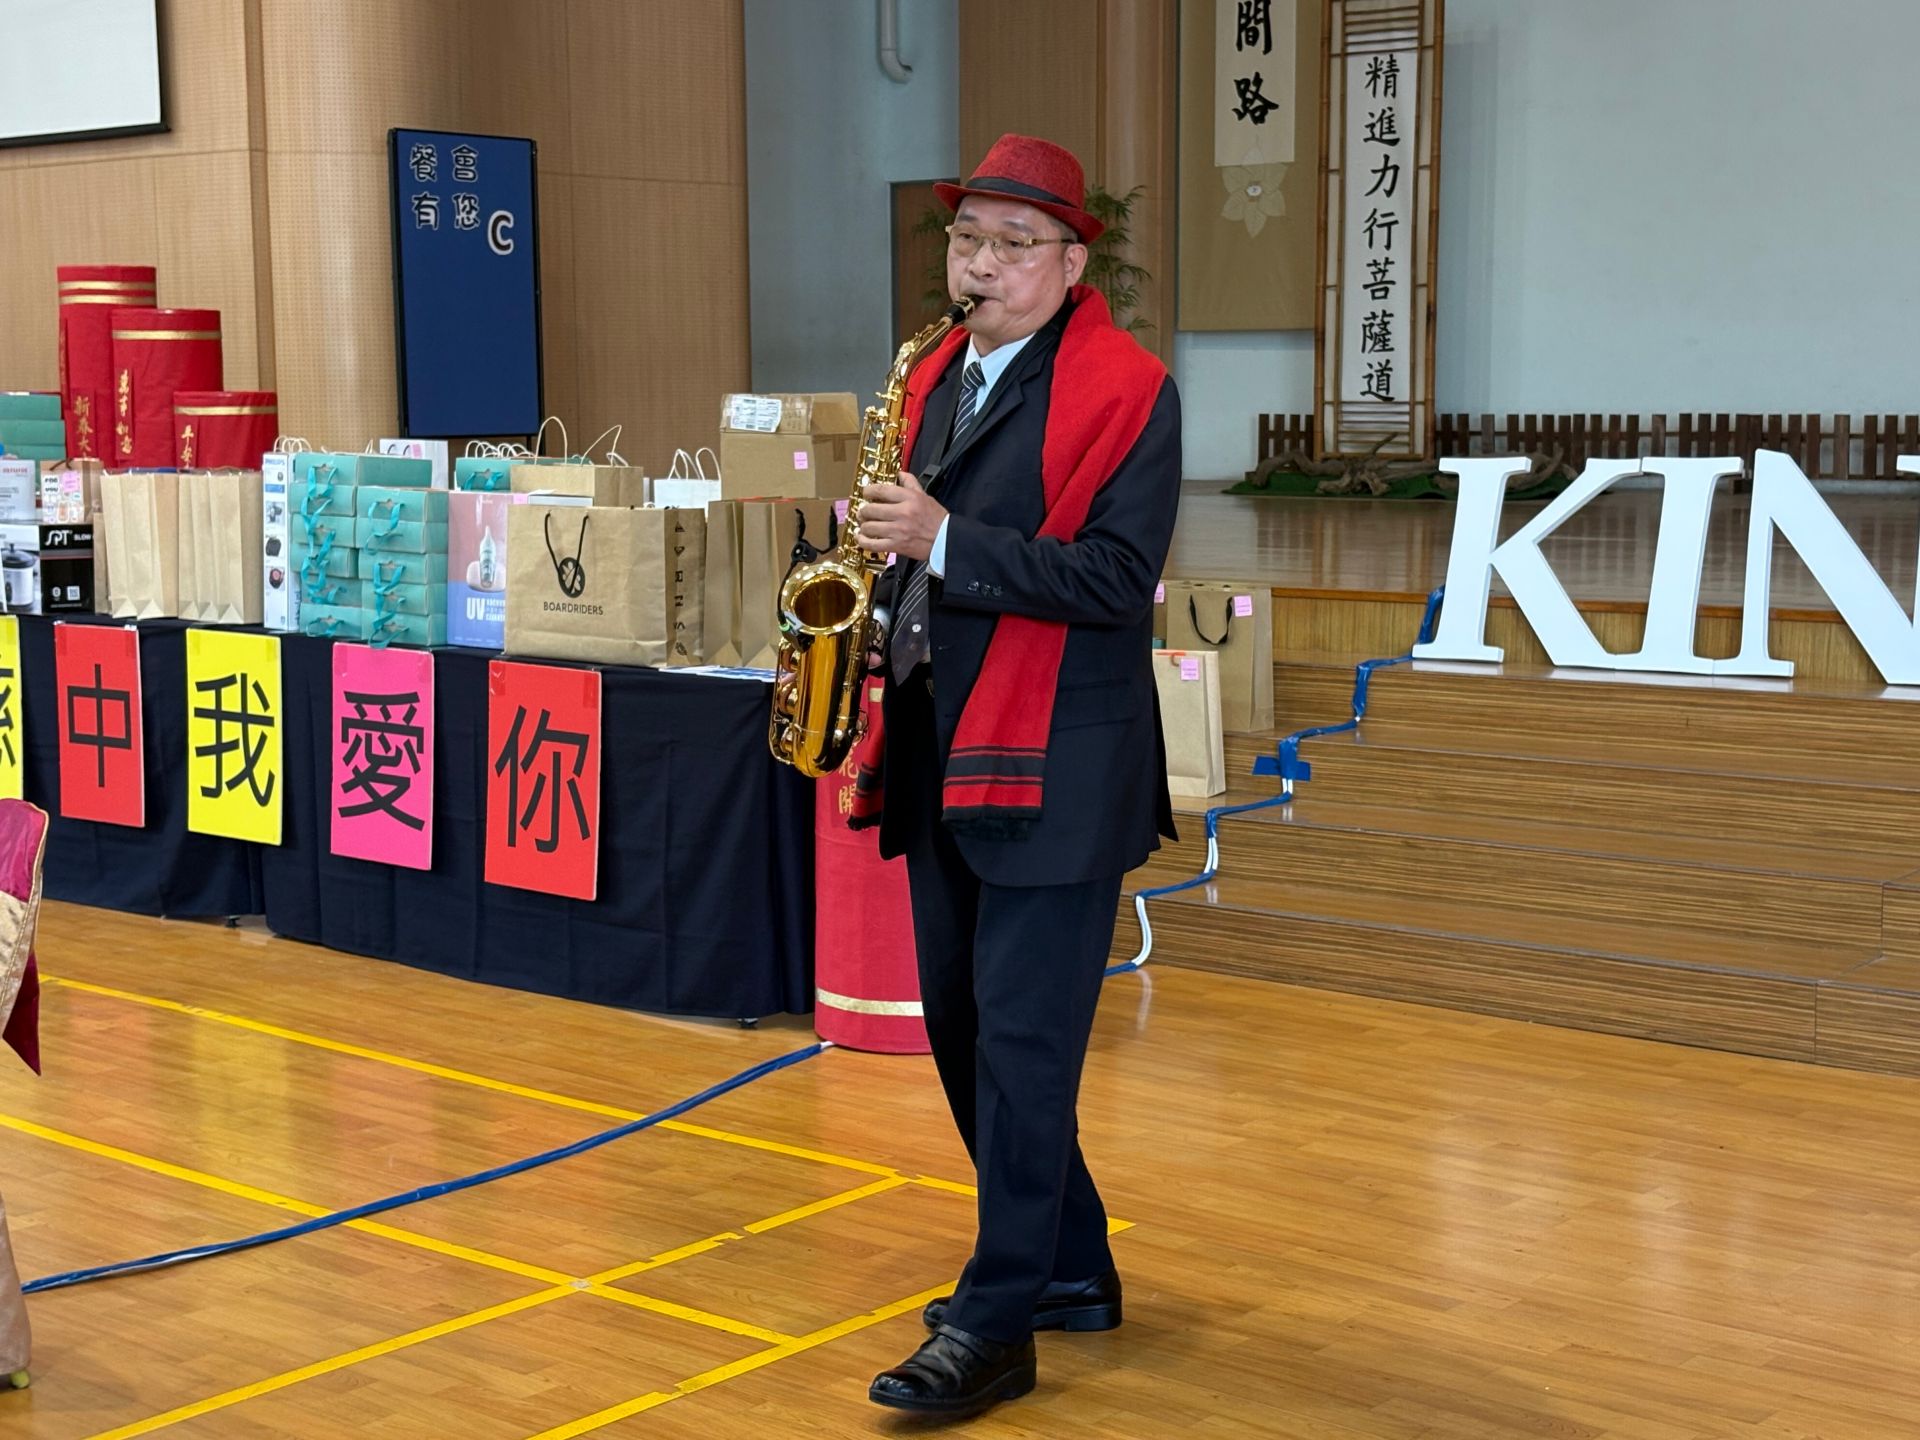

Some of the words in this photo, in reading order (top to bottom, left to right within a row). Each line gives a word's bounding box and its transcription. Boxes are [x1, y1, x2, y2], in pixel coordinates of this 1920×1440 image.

[409, 143, 479, 182] 餐會
[411, 191, 480, 230] 有您
[487, 210, 514, 255] C
[1360, 53, 1400, 402] 精進力行菩薩道
[74, 396, 94, 457] 新春大
[467, 597, 485, 620] UV
[543, 601, 604, 616] BOARDRIDERS
[1411, 448, 1920, 685] KIN
[67, 664, 131, 788] 中
[195, 673, 275, 807] 我
[339, 691, 425, 831] 愛
[495, 705, 590, 852] 你
